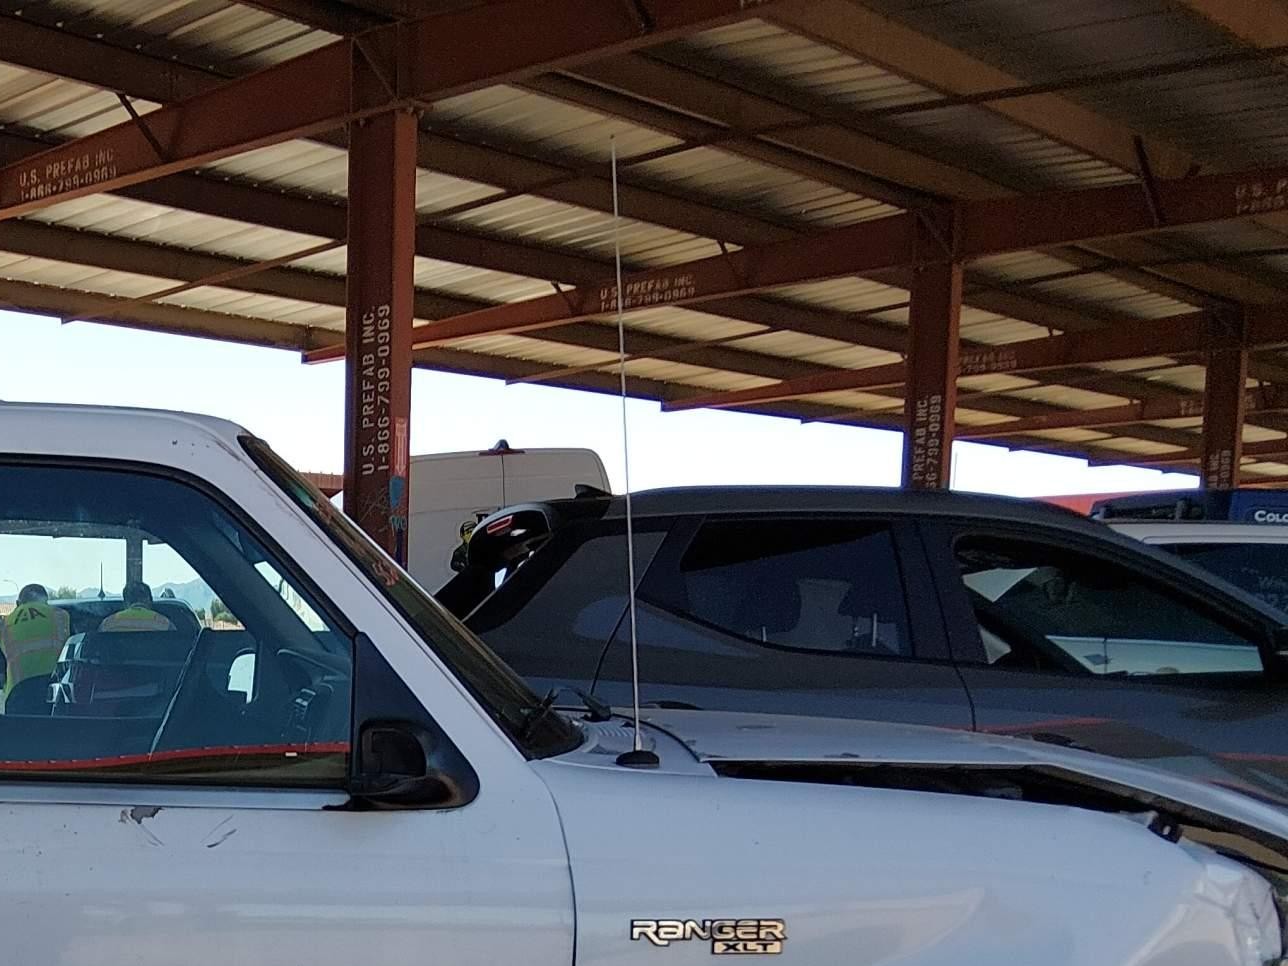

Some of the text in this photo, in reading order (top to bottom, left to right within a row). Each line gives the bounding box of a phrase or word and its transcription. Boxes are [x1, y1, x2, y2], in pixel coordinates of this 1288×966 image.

[45, 154, 90, 179] PREFAB
[626, 278, 670, 295] PREFAB
[362, 305, 376, 476] U.S. PREFAB INC.
[377, 304, 391, 471] 1-866-799-0969
[913, 427, 927, 481] PREFAB
[630, 919, 786, 947] RANGER
[716, 941, 778, 953] XLT
